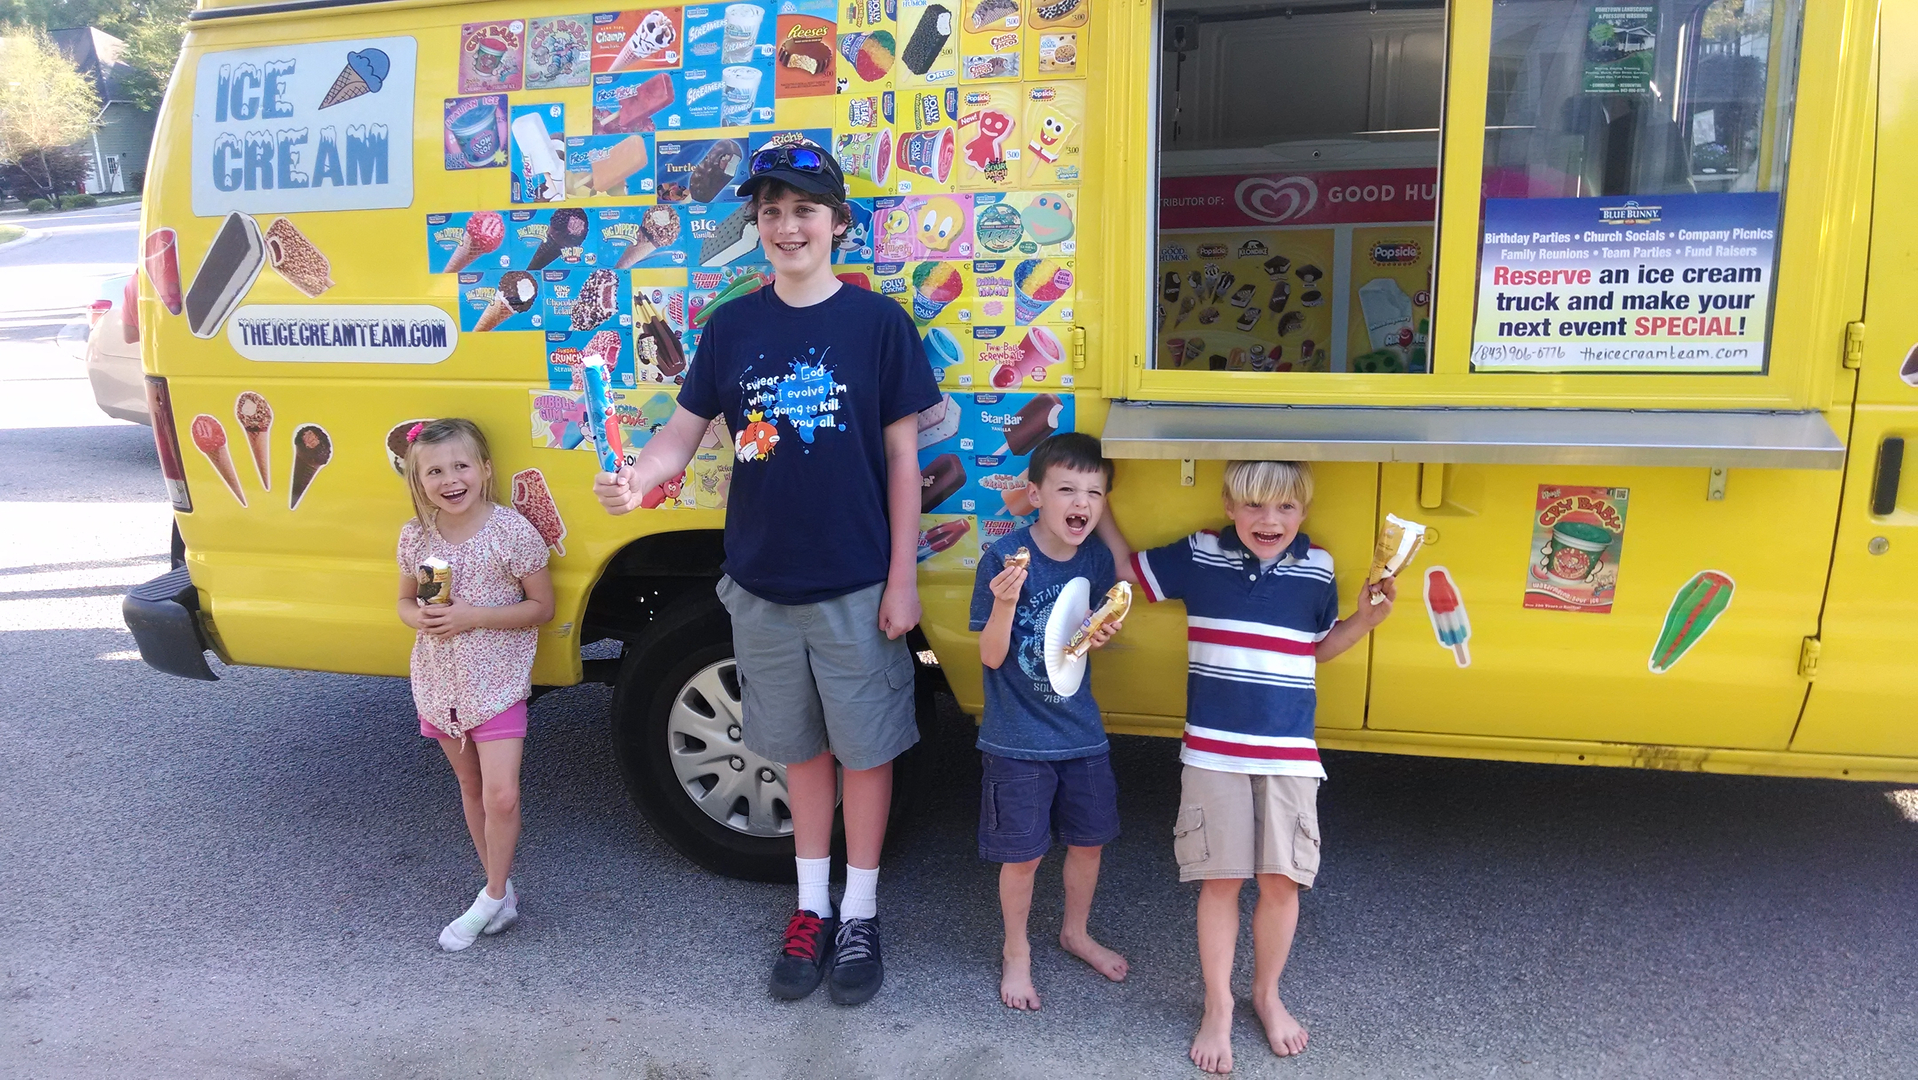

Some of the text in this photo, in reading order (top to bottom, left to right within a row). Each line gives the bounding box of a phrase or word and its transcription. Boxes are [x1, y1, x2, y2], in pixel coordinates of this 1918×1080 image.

[788, 24, 828, 38] Reese's
[990, 34, 1017, 46] CHOCO
[994, 39, 1018, 51] TACOS
[926, 70, 956, 82] OREO
[215, 58, 296, 122] ICE
[482, 96, 499, 105] ICE
[961, 113, 978, 126] New!
[772, 132, 804, 145] Rich's
[212, 123, 389, 192] CREAM
[665, 163, 696, 173] Turtle
[1328, 184, 1395, 203] GOOD
[1207, 196, 1224, 206] OF:
[1603, 208, 1658, 220] BLUE BUNNY
[527, 224, 549, 238] DIPPER
[602, 223, 640, 239] BIG DIPPER
[690, 219, 716, 232] BIG
[443, 227, 464, 239] DIPPER
[1485, 227, 1773, 245] Birthday Parties Church Socials Company Picnics
[1374, 246, 1417, 259] Popsicle
[1501, 245, 1757, 262] Family Reunions Team Parties Fund Raisers
[1493, 265, 1762, 286] Reserve an ice cream
[882, 278, 904, 289] JOLLY
[475, 287, 496, 299] DIPPER
[1496, 290, 1755, 314] truck and make your
[238, 317, 447, 348] THEICECREAMTEAM.COM
[1498, 315, 1746, 337] next event SPECIAL!
[550, 352, 582, 364] CRUNCH
[1580, 346, 1748, 361] theicecreamteam.com
[746, 375, 779, 391] swear
[783, 373, 797, 382] to
[801, 364, 825, 381] God
[748, 391, 775, 406] when
[787, 385, 825, 399] evolve
[829, 381, 847, 396] I'm
[534, 395, 577, 410] BUBBLE
[539, 408, 562, 423] GUM
[773, 404, 803, 418] going
[805, 404, 818, 413] to
[980, 411, 1022, 425] Star Bar
[819, 415, 836, 428] all.
[1540, 497, 1621, 531] CRY BABY
